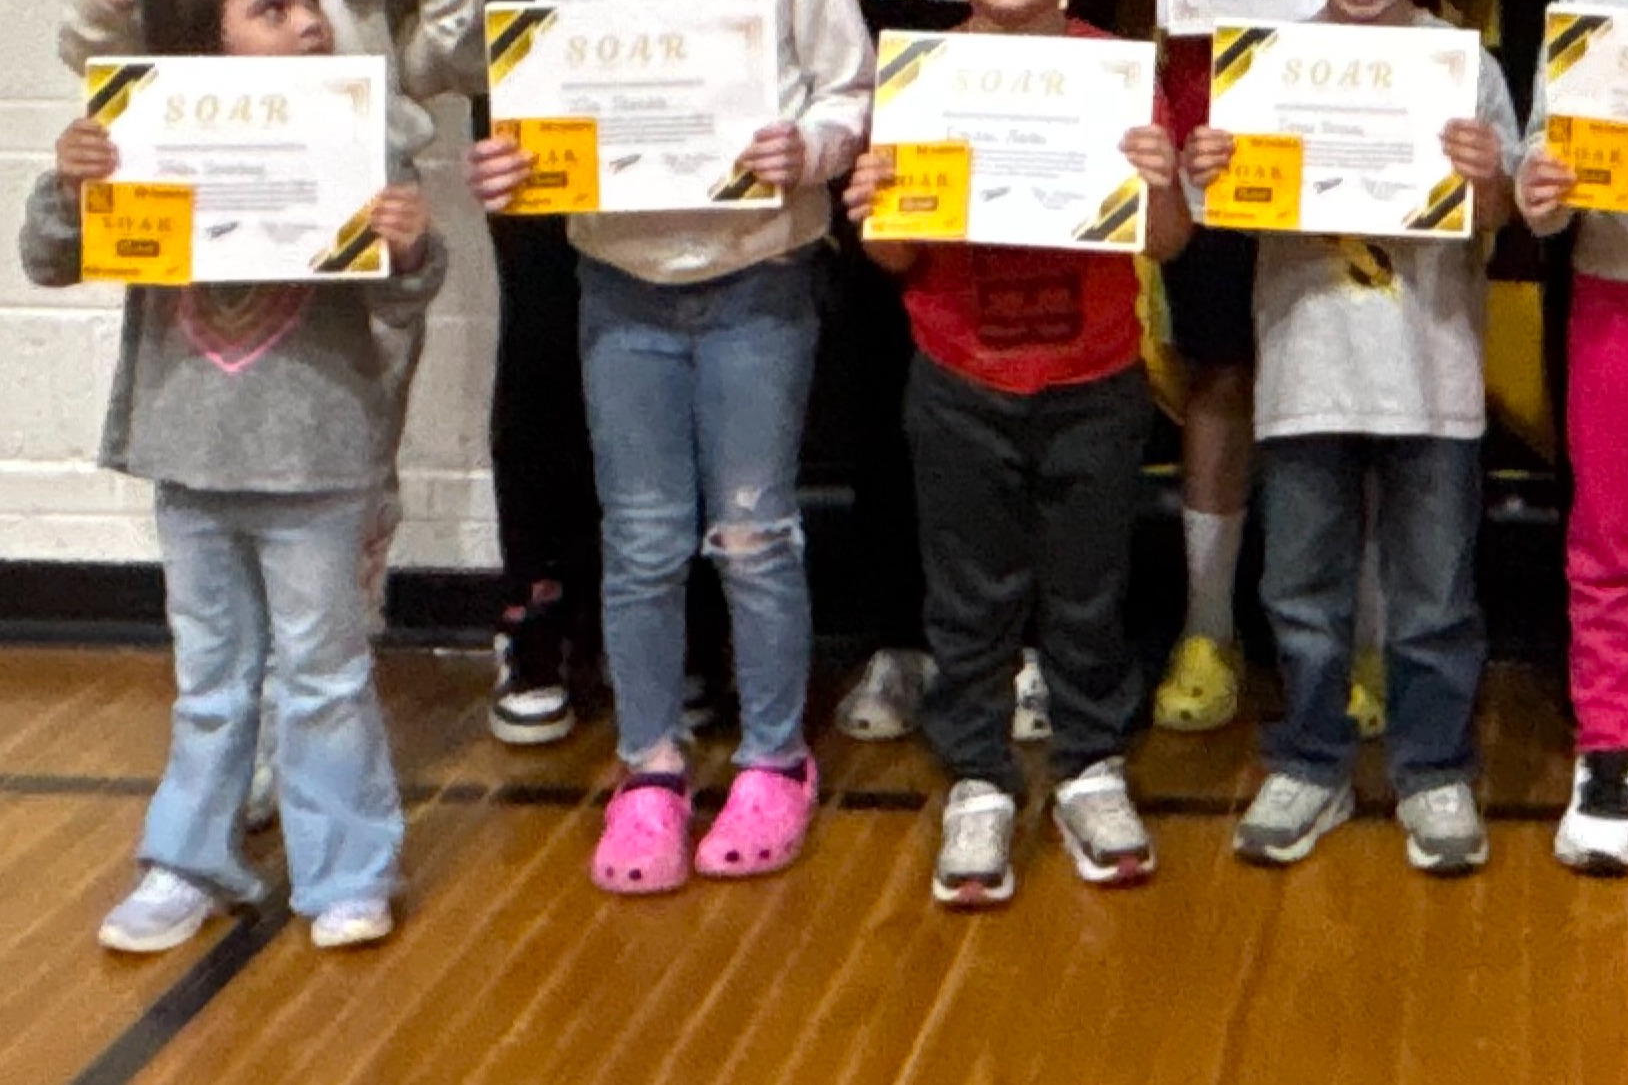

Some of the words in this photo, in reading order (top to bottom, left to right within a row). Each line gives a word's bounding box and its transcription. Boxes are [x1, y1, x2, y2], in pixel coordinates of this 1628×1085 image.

[566, 32, 688, 64] SOAR
[952, 67, 1066, 96] SOAR
[1282, 57, 1393, 89] SOAR
[163, 93, 290, 124] SOAR
